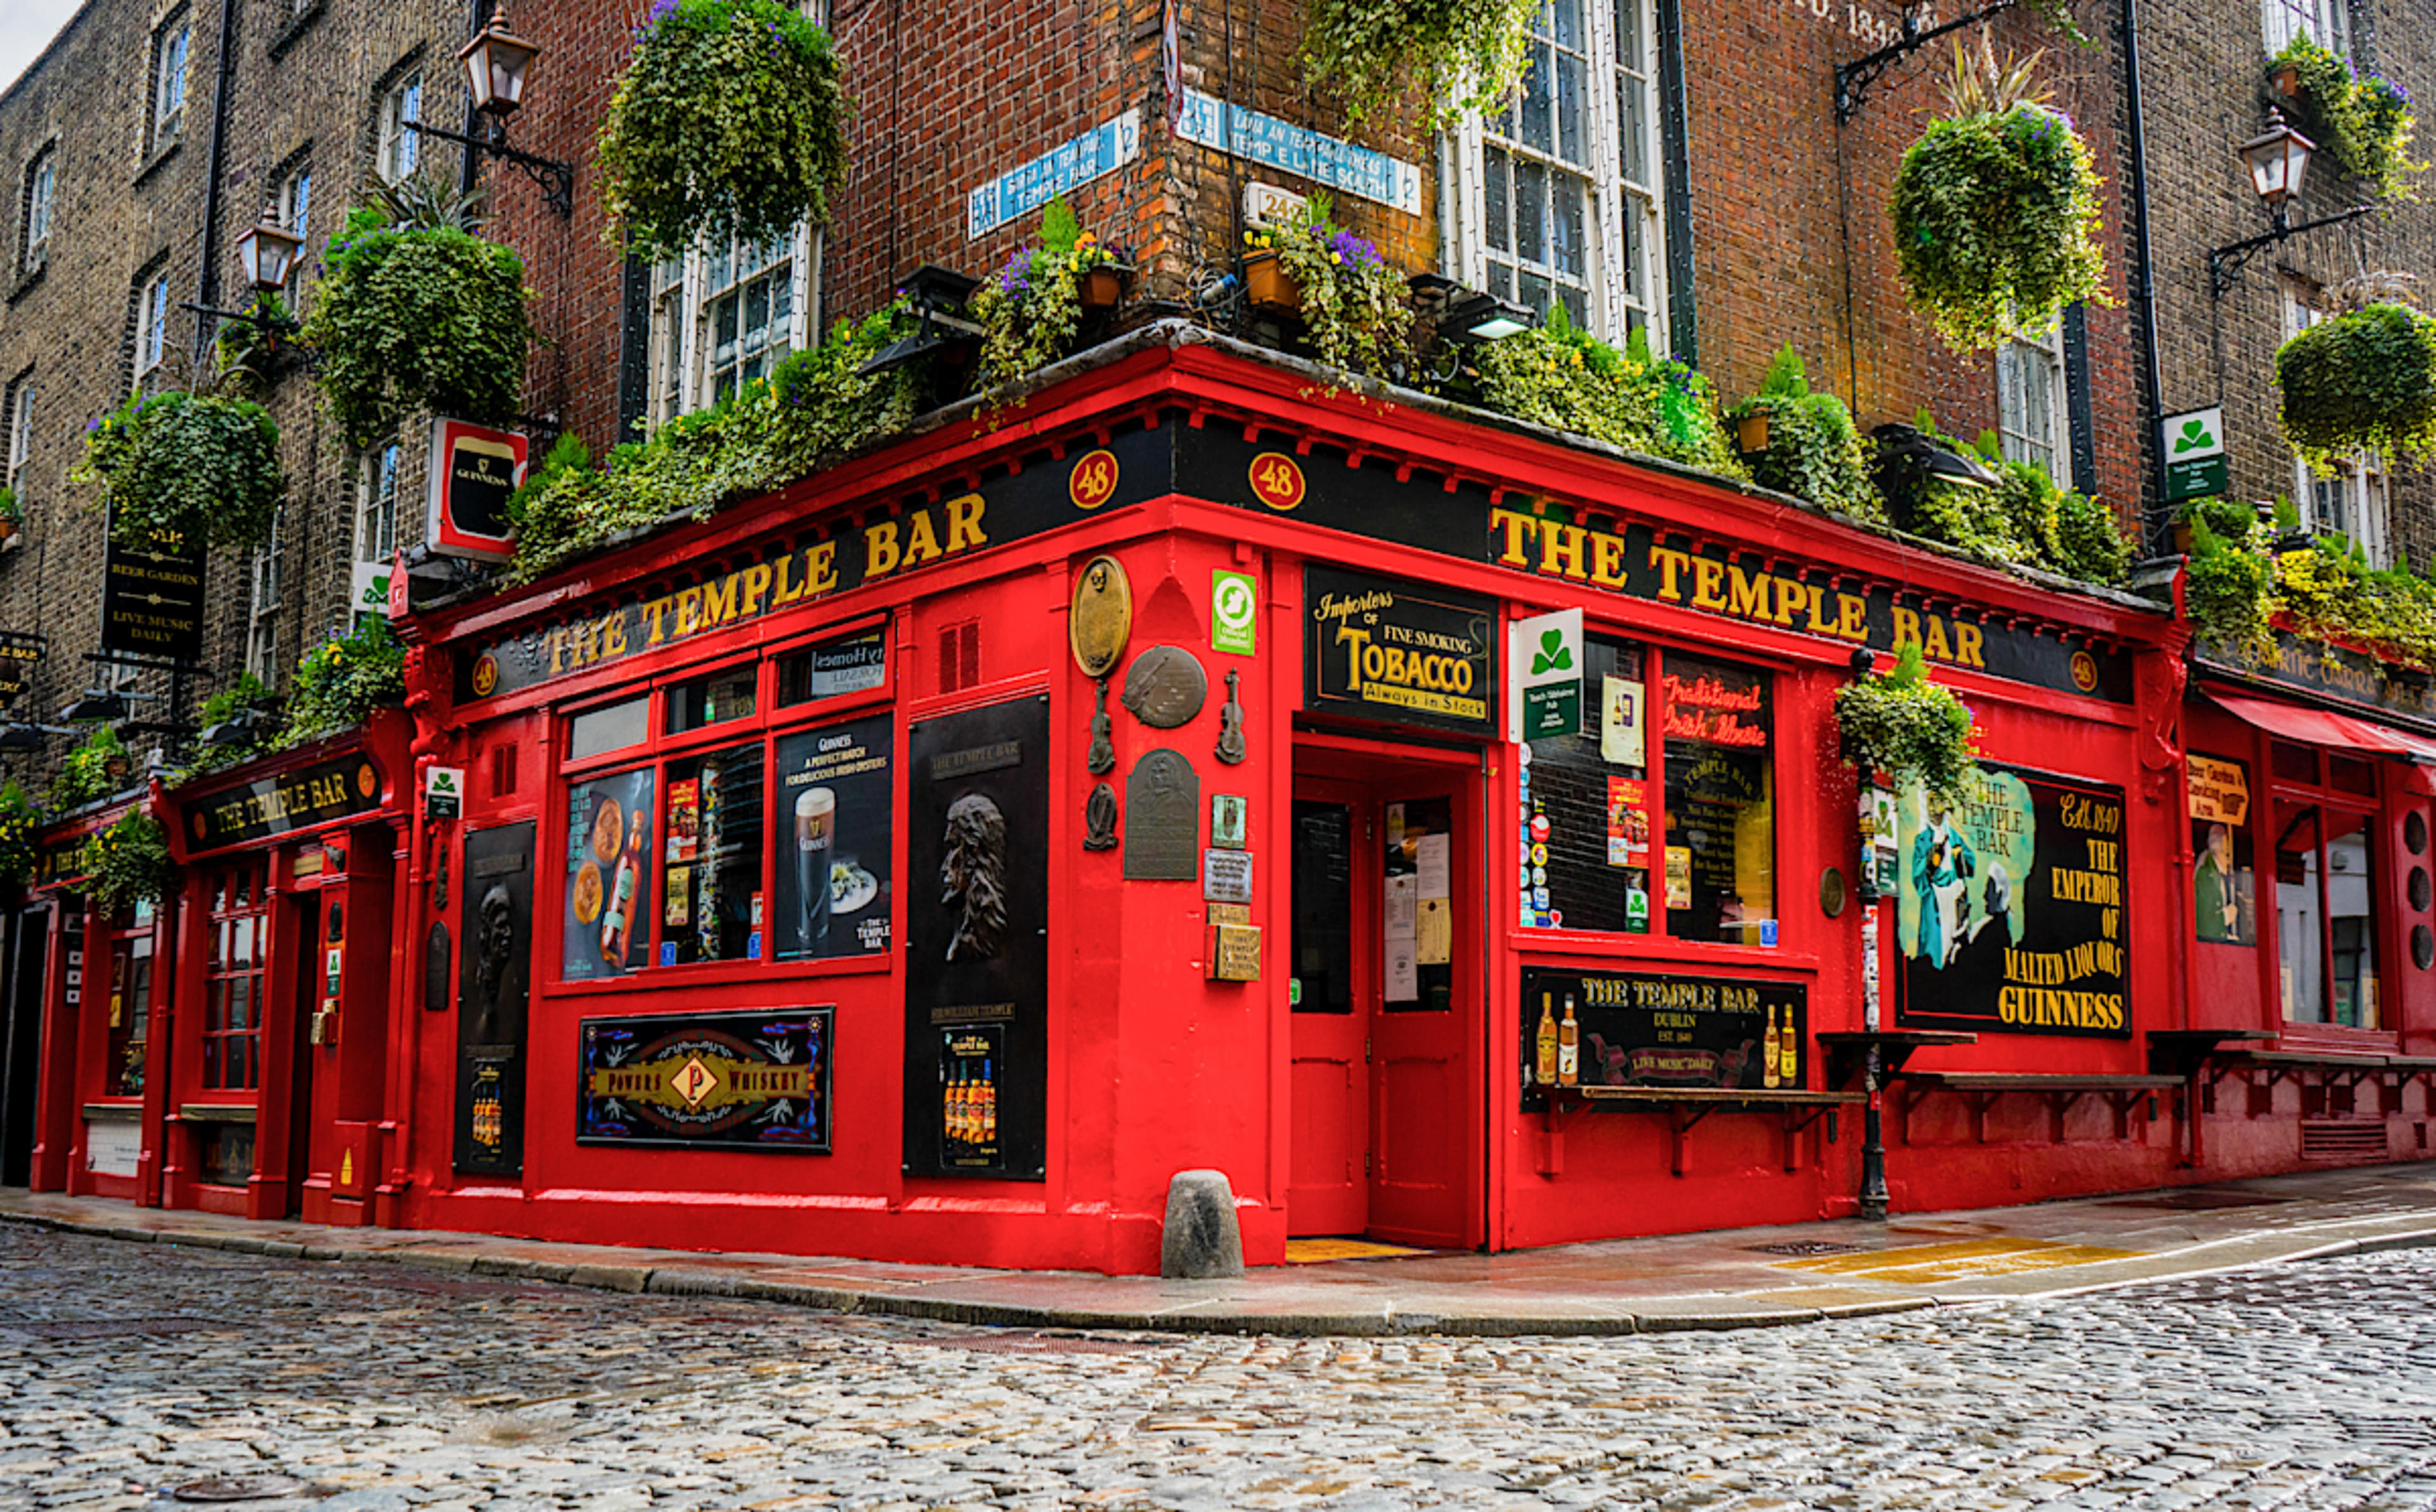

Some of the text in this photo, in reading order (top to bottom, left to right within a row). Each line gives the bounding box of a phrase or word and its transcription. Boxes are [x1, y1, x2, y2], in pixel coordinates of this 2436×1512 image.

[1269, 123, 1283, 141] AN
[1069, 159, 1097, 184] BAR
[1337, 167, 1387, 202] SOUTH
[456, 467, 508, 486] GUINNESS
[1078, 460, 1110, 500] 48
[1258, 460, 1293, 497] 48
[112, 563, 199, 585] BEER GARDEN
[544, 492, 989, 676] THE TEMPLE BAR
[1490, 507, 1986, 671] THE TEMPLE BAR
[113, 610, 193, 632] LIVE MUSIC
[1313, 590, 1394, 625] Importers
[1363, 612, 1378, 625] OF
[131, 626, 174, 642] DAILY
[1384, 624, 1472, 654] FINE SMOKING
[1335, 624, 1473, 694] TOBACCO
[2074, 658, 2092, 684] 48
[1365, 682, 1484, 716] Always in Stock
[1662, 673, 1762, 711] Traditional
[1663, 703, 1767, 747] Irish Music
[1682, 759, 1729, 786] TEMPLE
[214, 802, 246, 833] THE
[245, 784, 310, 824] TEMPLE
[308, 772, 348, 809] BAR
[1973, 781, 2009, 807] THE
[1961, 802, 2024, 835] TEMPLE
[1976, 829, 2011, 858] BAR
[2086, 837, 2118, 873] THE
[2051, 865, 2121, 908] EMPEROR
[2102, 907, 2119, 940] OF
[2003, 939, 2125, 986] MALTED LIQUORS
[1581, 977, 1762, 1014] THE TEMPLE BAR
[1999, 985, 2125, 1030] GUINNESS
[1653, 1012, 1698, 1028] DUBLIN
[1657, 1030, 1675, 1042] EST.
[1632, 1057, 1715, 1071] LIVE MUSIC DAILY
[608, 1070, 801, 1093] POWERS WHISKEY
[688, 1064, 704, 1100] P
